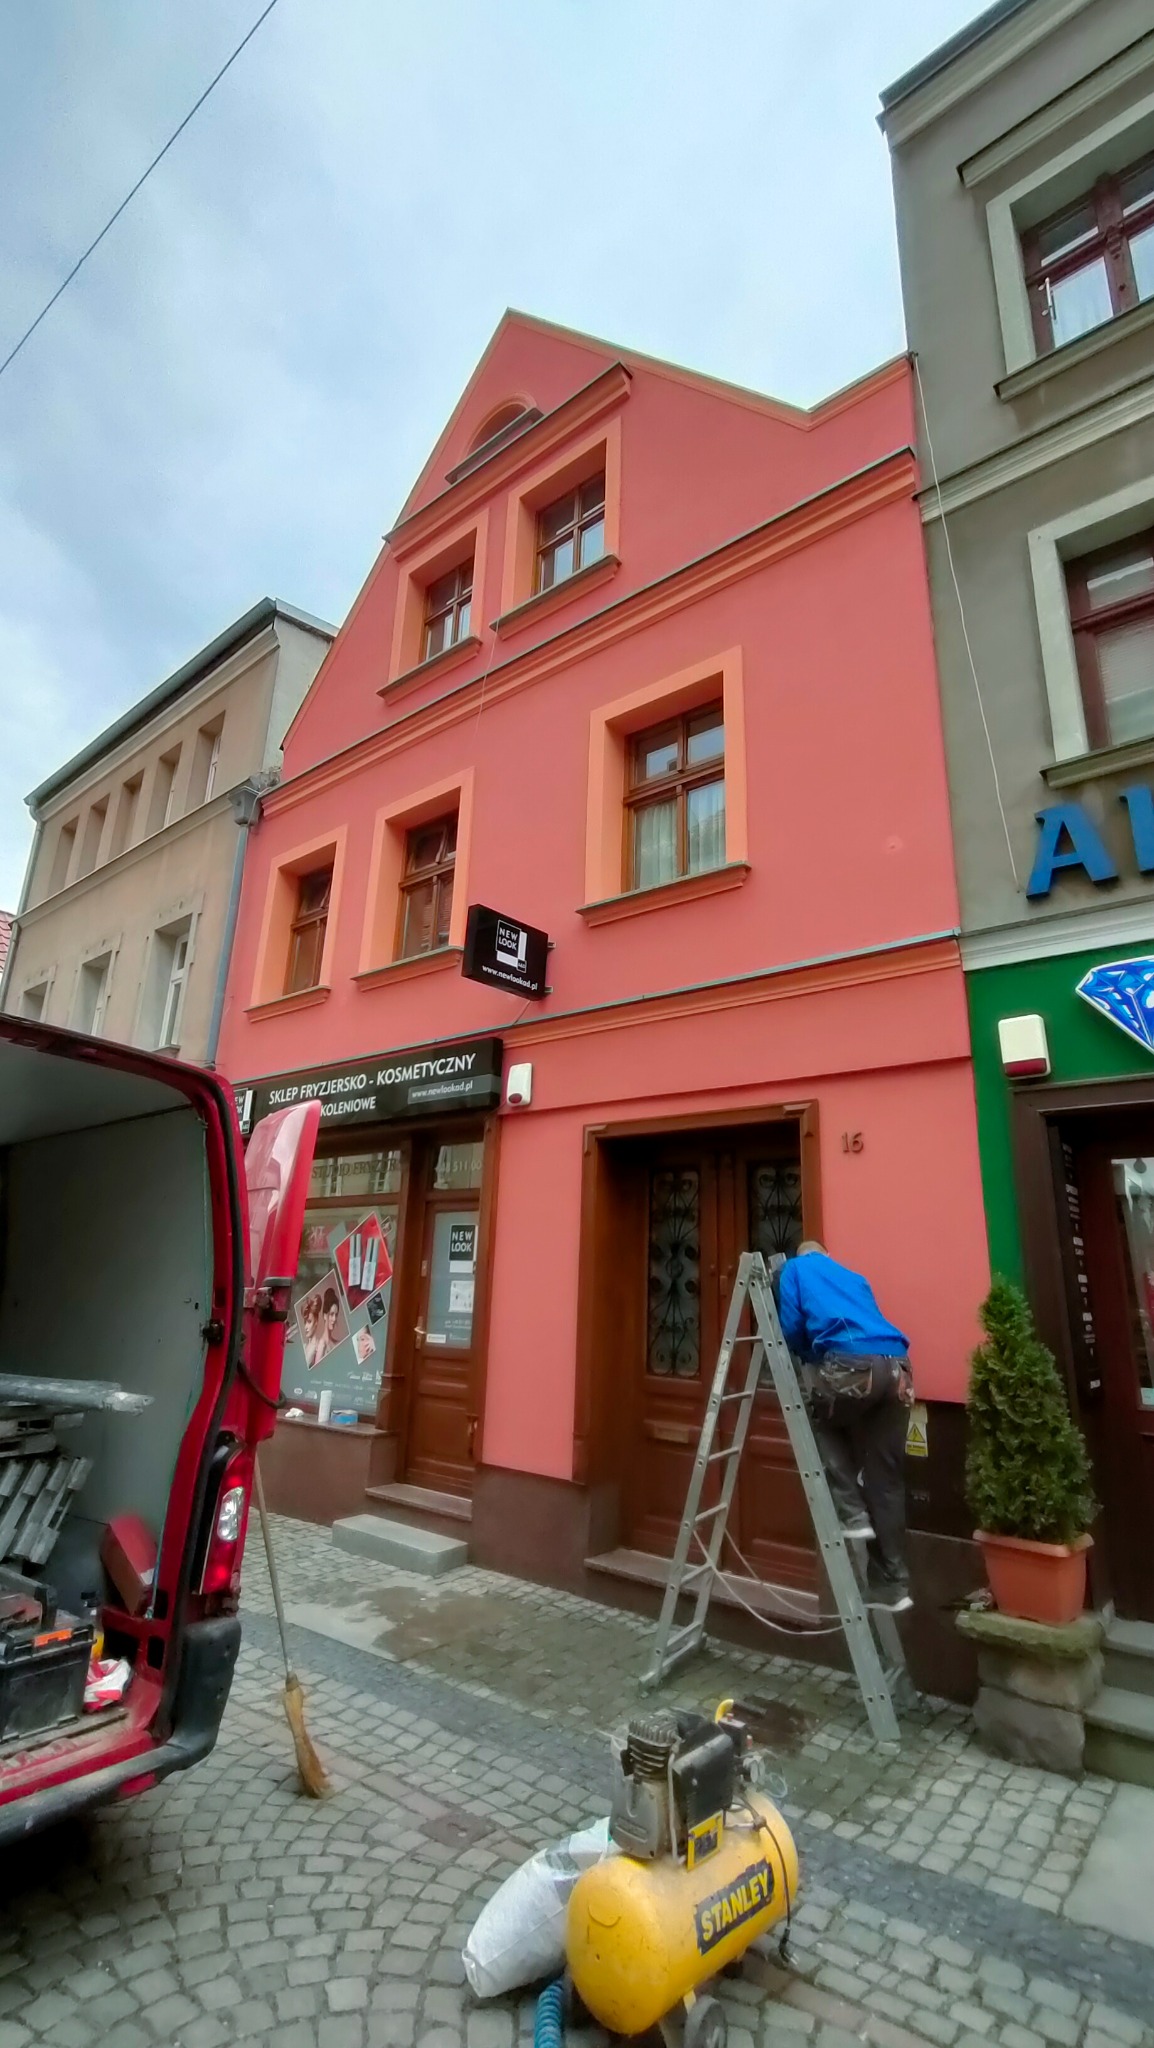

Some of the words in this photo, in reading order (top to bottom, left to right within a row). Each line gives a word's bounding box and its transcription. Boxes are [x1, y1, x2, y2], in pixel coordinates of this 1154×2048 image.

[499, 937, 517, 950] LOOK
[500, 928, 518, 941] NEW
[482, 965, 538, 990] www.newlookad.pl
[269, 1087, 298, 1105] SKLEP
[300, 1074, 366, 1099] FRYZJERSKO
[377, 1053, 476, 1085] KOSMETYCZNY
[320, 1096, 376, 1117] KOLENIOWE
[842, 1132, 864, 1153] 16
[452, 1231, 473, 1241] NEW
[451, 1242, 472, 1252] LOOK
[701, 1869, 768, 1941] STANLEY
